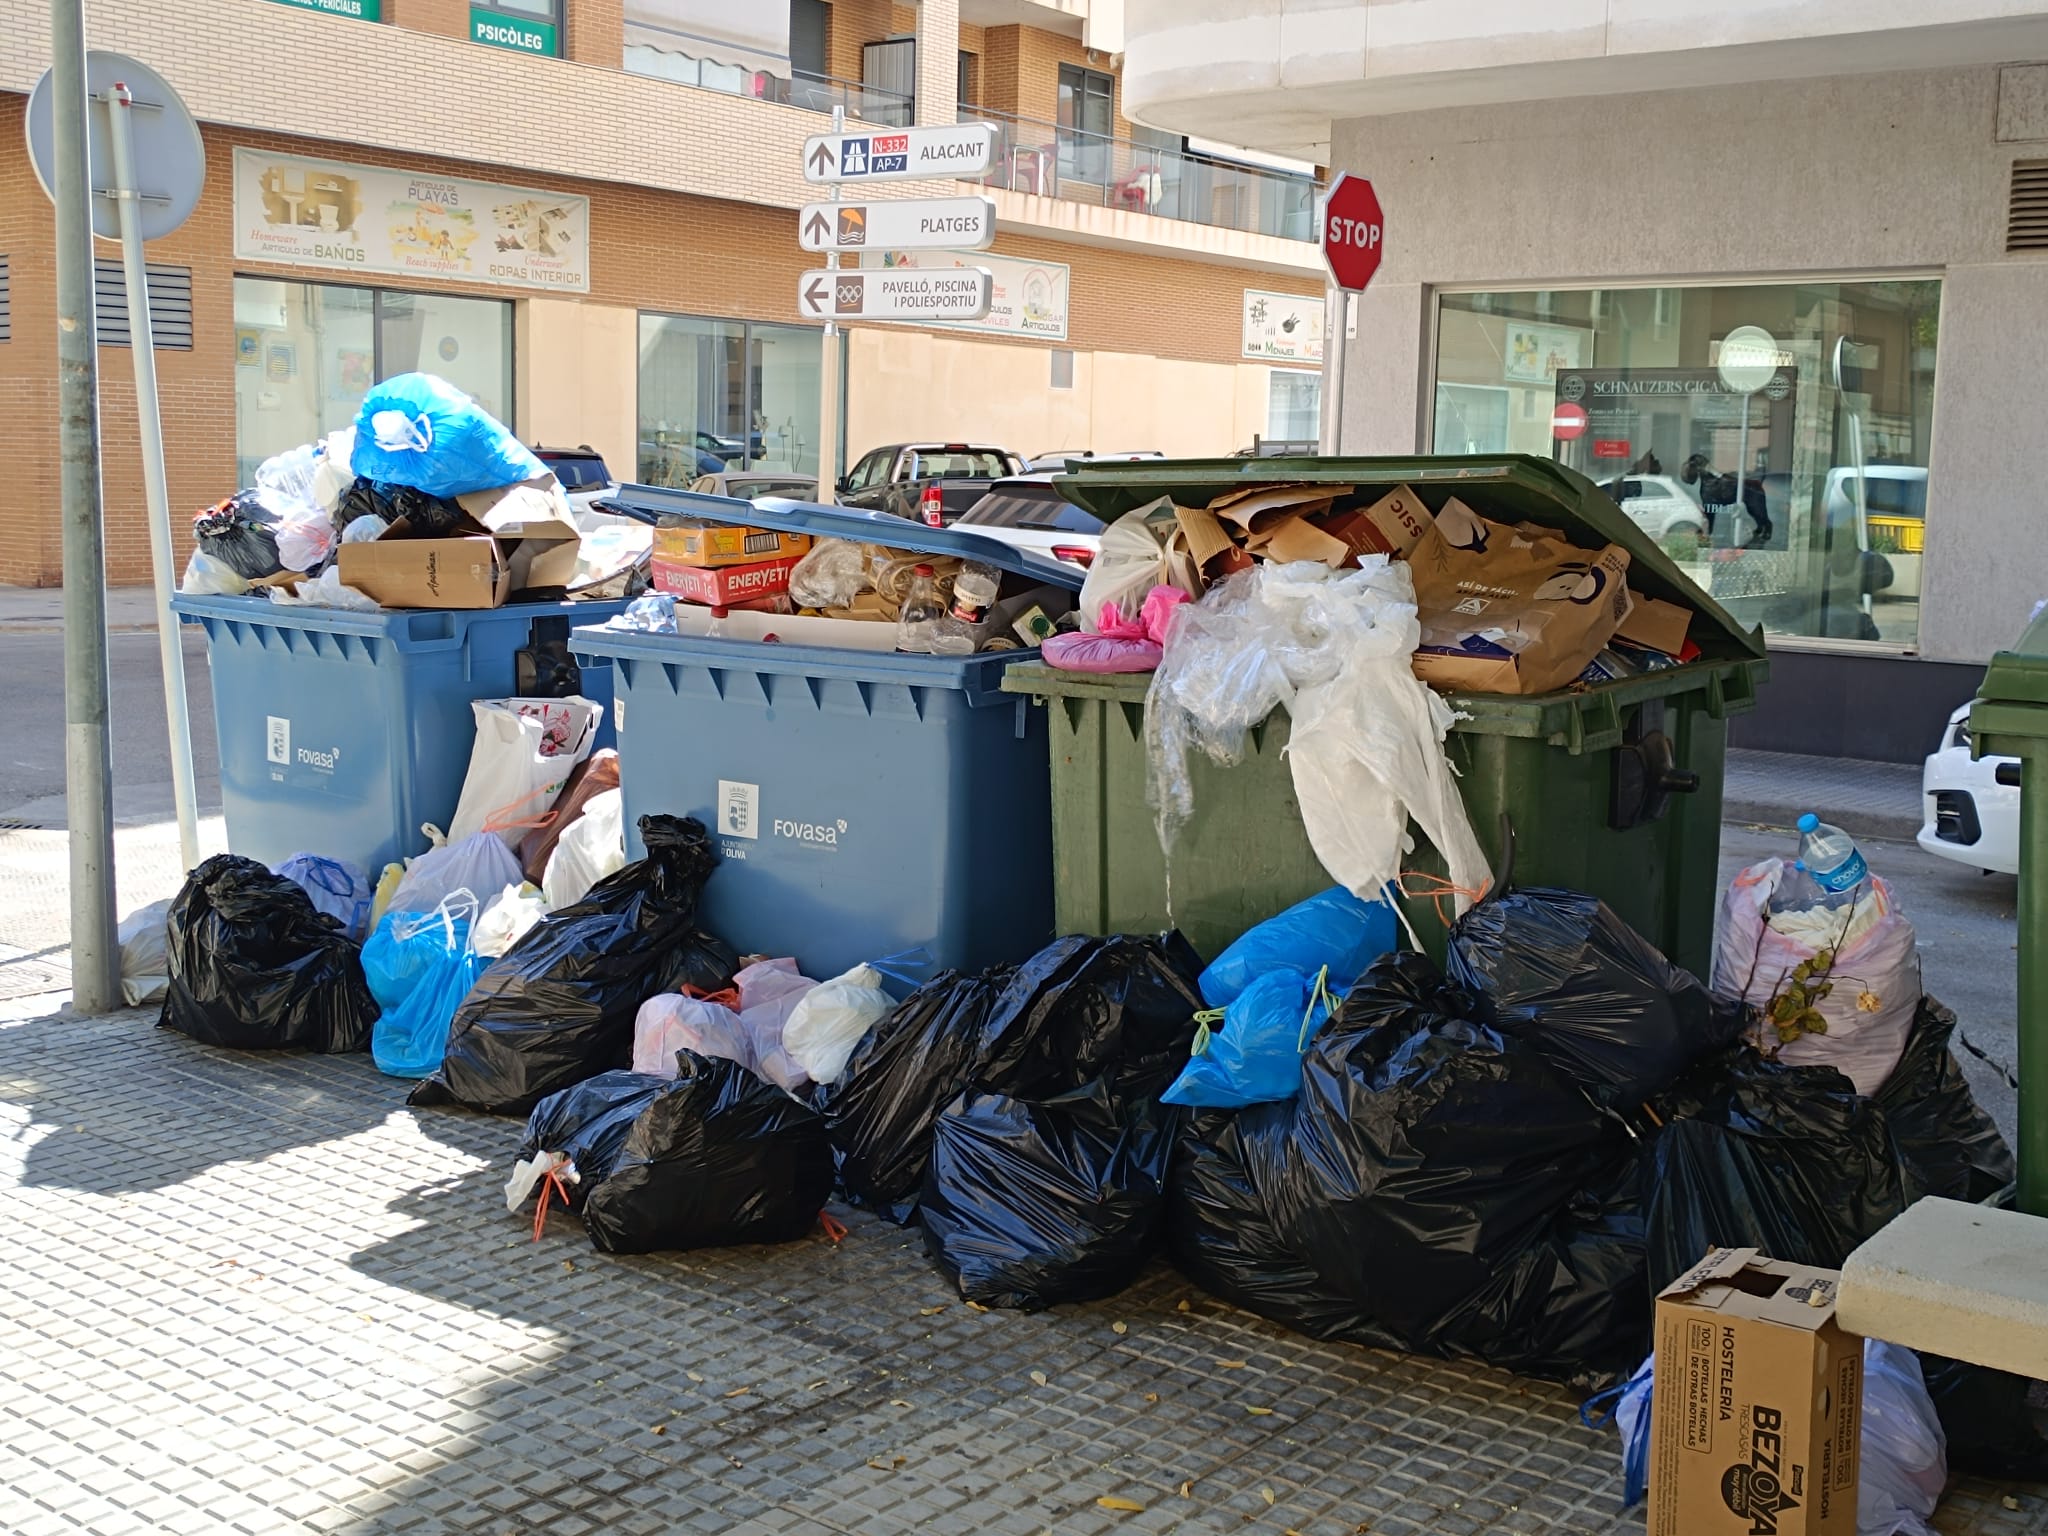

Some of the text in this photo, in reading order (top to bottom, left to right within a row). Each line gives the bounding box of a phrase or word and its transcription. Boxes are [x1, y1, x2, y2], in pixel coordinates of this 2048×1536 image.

[477, 23, 543, 50] PSICÒLEG
[873, 139, 907, 154] N-332
[920, 142, 984, 160] ALACANT
[876, 157, 903, 171] AP-7
[408, 187, 459, 205] PLAYAS
[921, 217, 979, 233] PLATGES
[1329, 216, 1380, 249] STOP
[251, 229, 298, 244] Homeware
[314, 242, 365, 262] BAÑOS
[489, 264, 582, 284] ROPAS INTERIOR
[882, 278, 931, 294] PAVELLÓ,
[935, 280, 977, 292] PISCINA
[894, 295, 976, 308] I POLIESPORTIU
[1593, 380, 1682, 394] SCHNAUZERS
[728, 566, 789, 590] ENERYETI
[1690, 1356, 1699, 1368] DE
[1719, 1326, 1735, 1421] HOSTELERÍA
[1689, 1369, 1699, 1400] OTRAS
[1698, 1358, 1710, 1444] BOTELLAS HECHAS
[1688, 1401, 1698, 1447] BOTELLAS
[1738, 1404, 1751, 1460] TRESCASAS
[1748, 1405, 1782, 1536] BEZOYA
